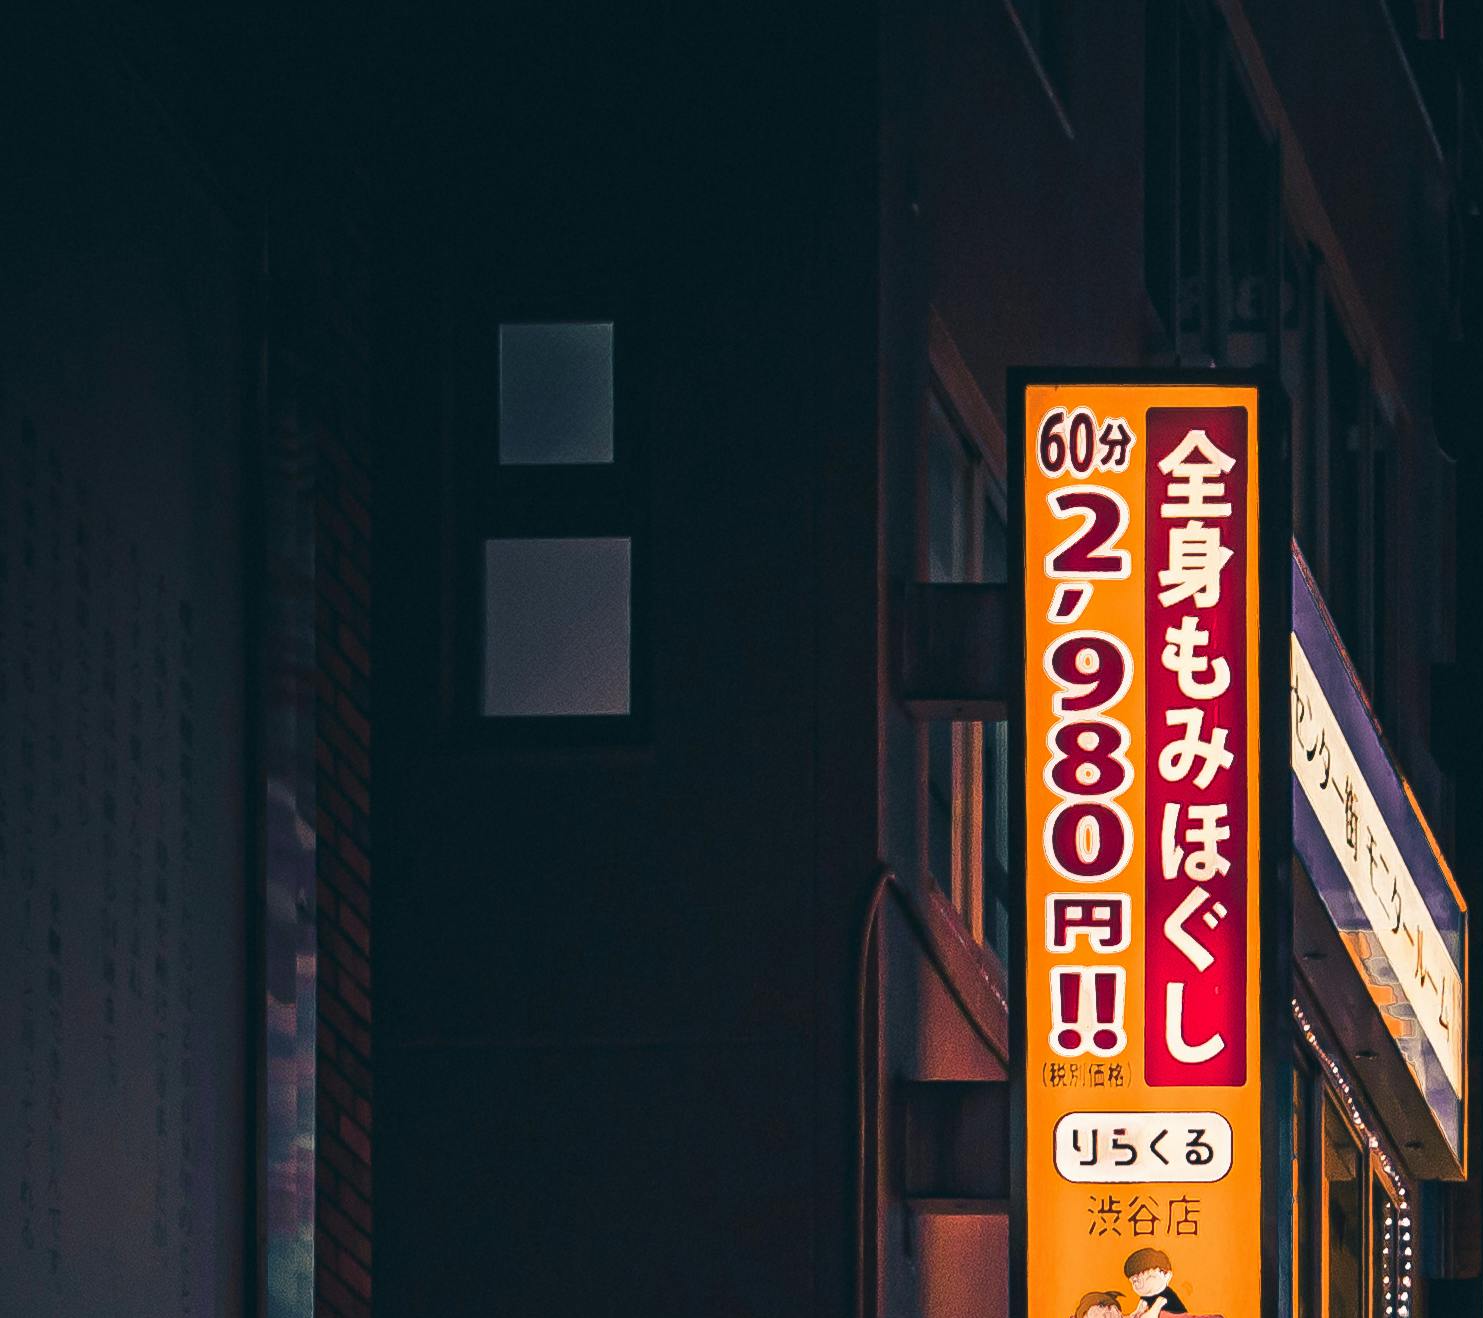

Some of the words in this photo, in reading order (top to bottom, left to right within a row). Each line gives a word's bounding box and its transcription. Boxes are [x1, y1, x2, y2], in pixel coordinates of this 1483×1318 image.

[1037, 406, 1133, 478] 60分
[1156, 428, 1237, 1065] 全身もみほぐし
[1070, 1126, 1216, 1166] りらくる
[1086, 1194, 1202, 1240] 渋谷店
